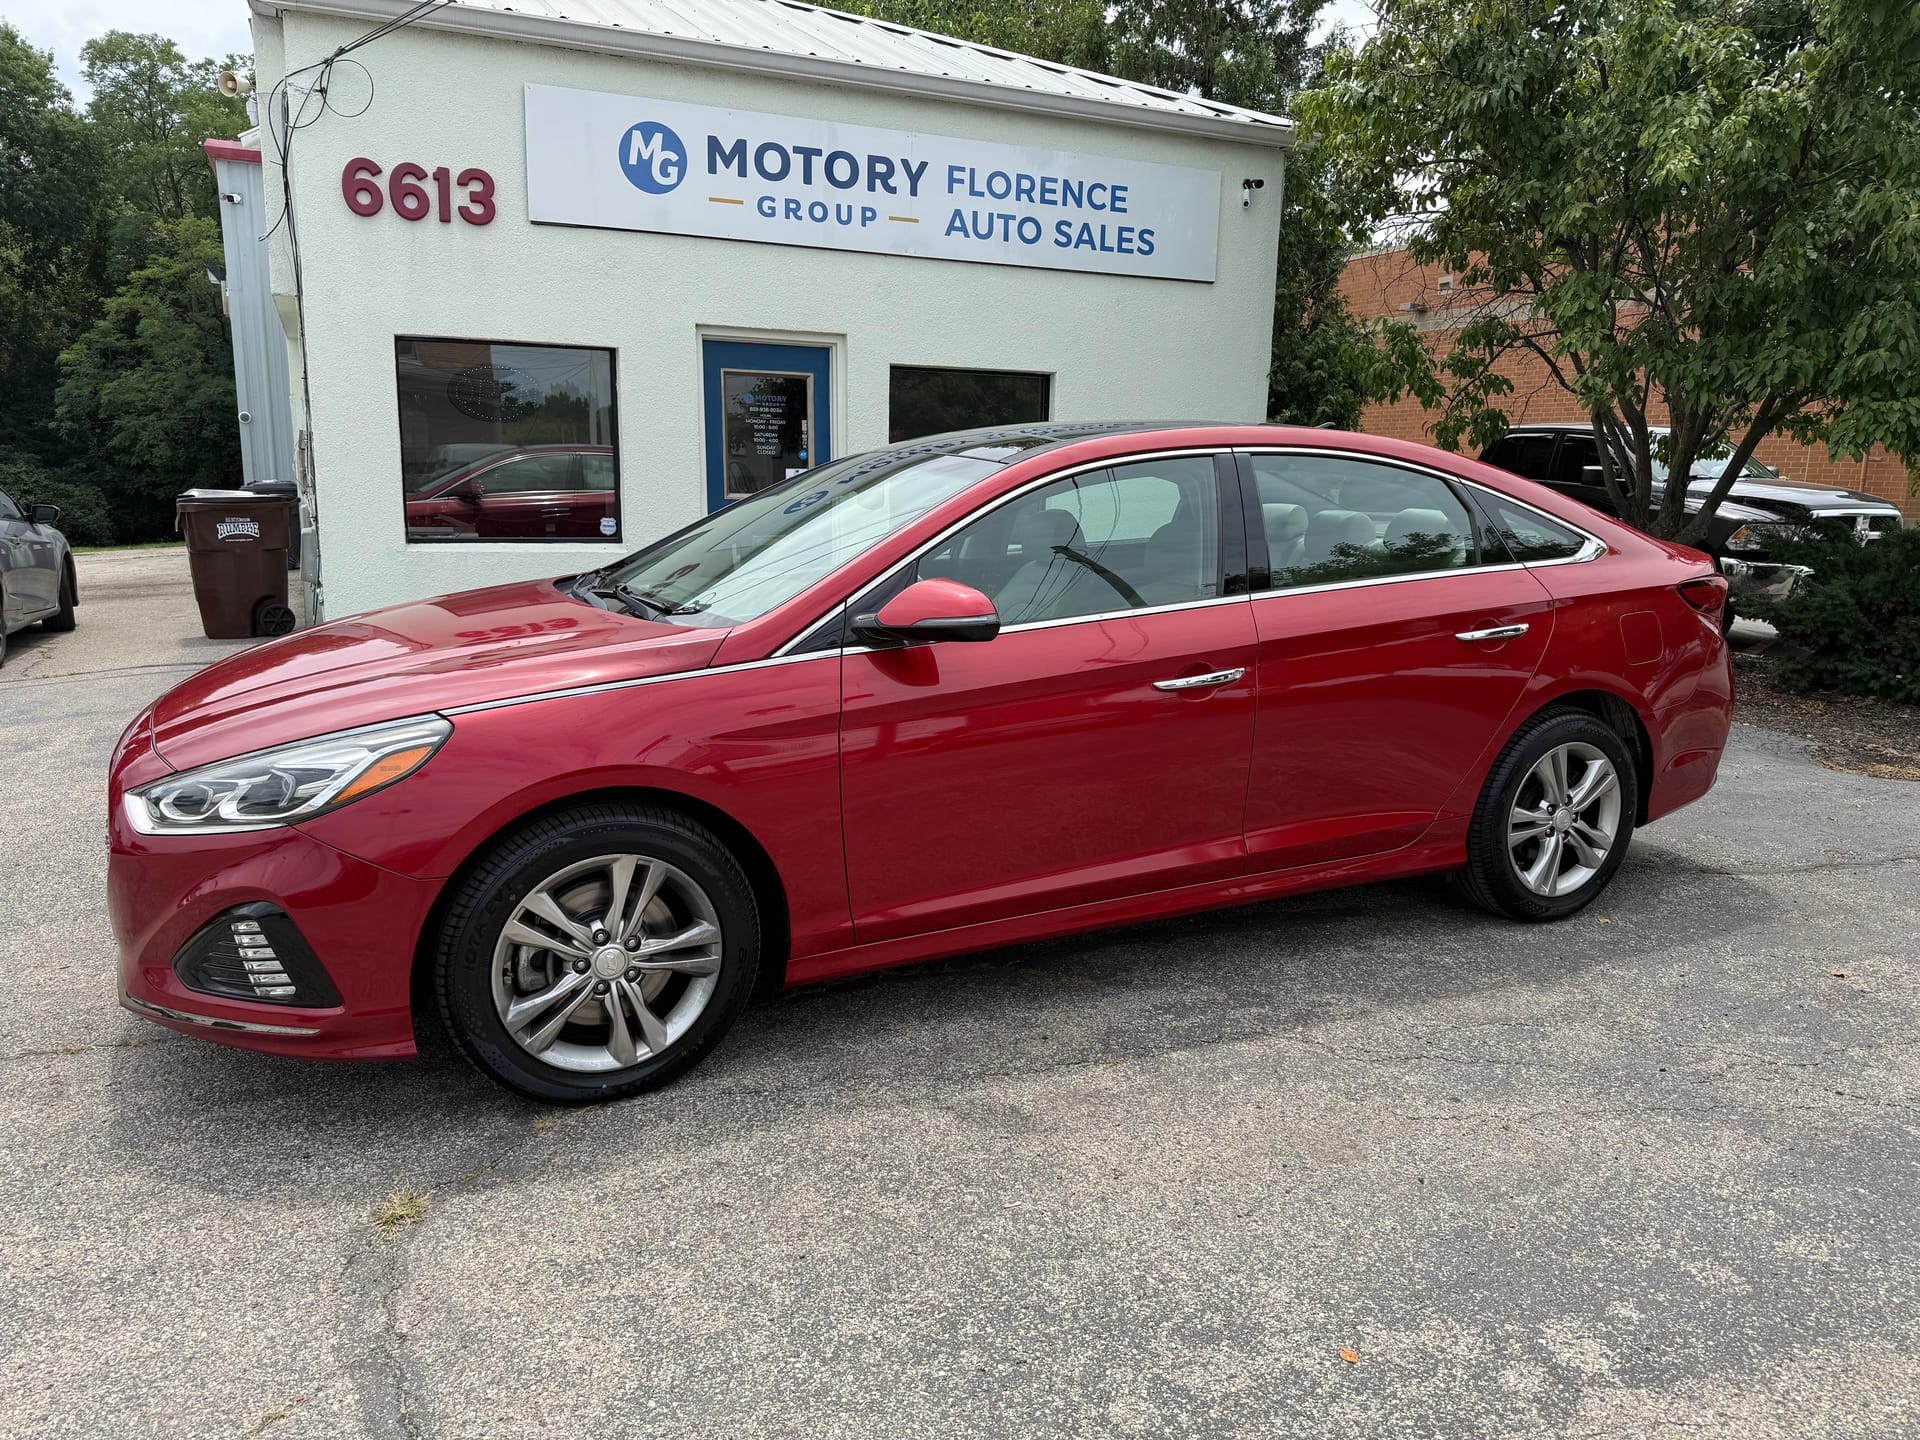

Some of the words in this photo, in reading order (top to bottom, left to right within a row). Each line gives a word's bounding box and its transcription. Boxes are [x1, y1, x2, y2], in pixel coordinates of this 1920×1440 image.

[628, 129, 680, 186] MG
[706, 135, 929, 198] MOTORY
[341, 157, 496, 226] 6613
[756, 195, 878, 228] GROUP
[947, 164, 1128, 214] FLORENCE
[944, 208, 1042, 245] AUTO
[1053, 218, 1156, 257] SALES
[755, 394, 787, 402] MOTORY
[217, 522, 259, 539] RUMPKE
